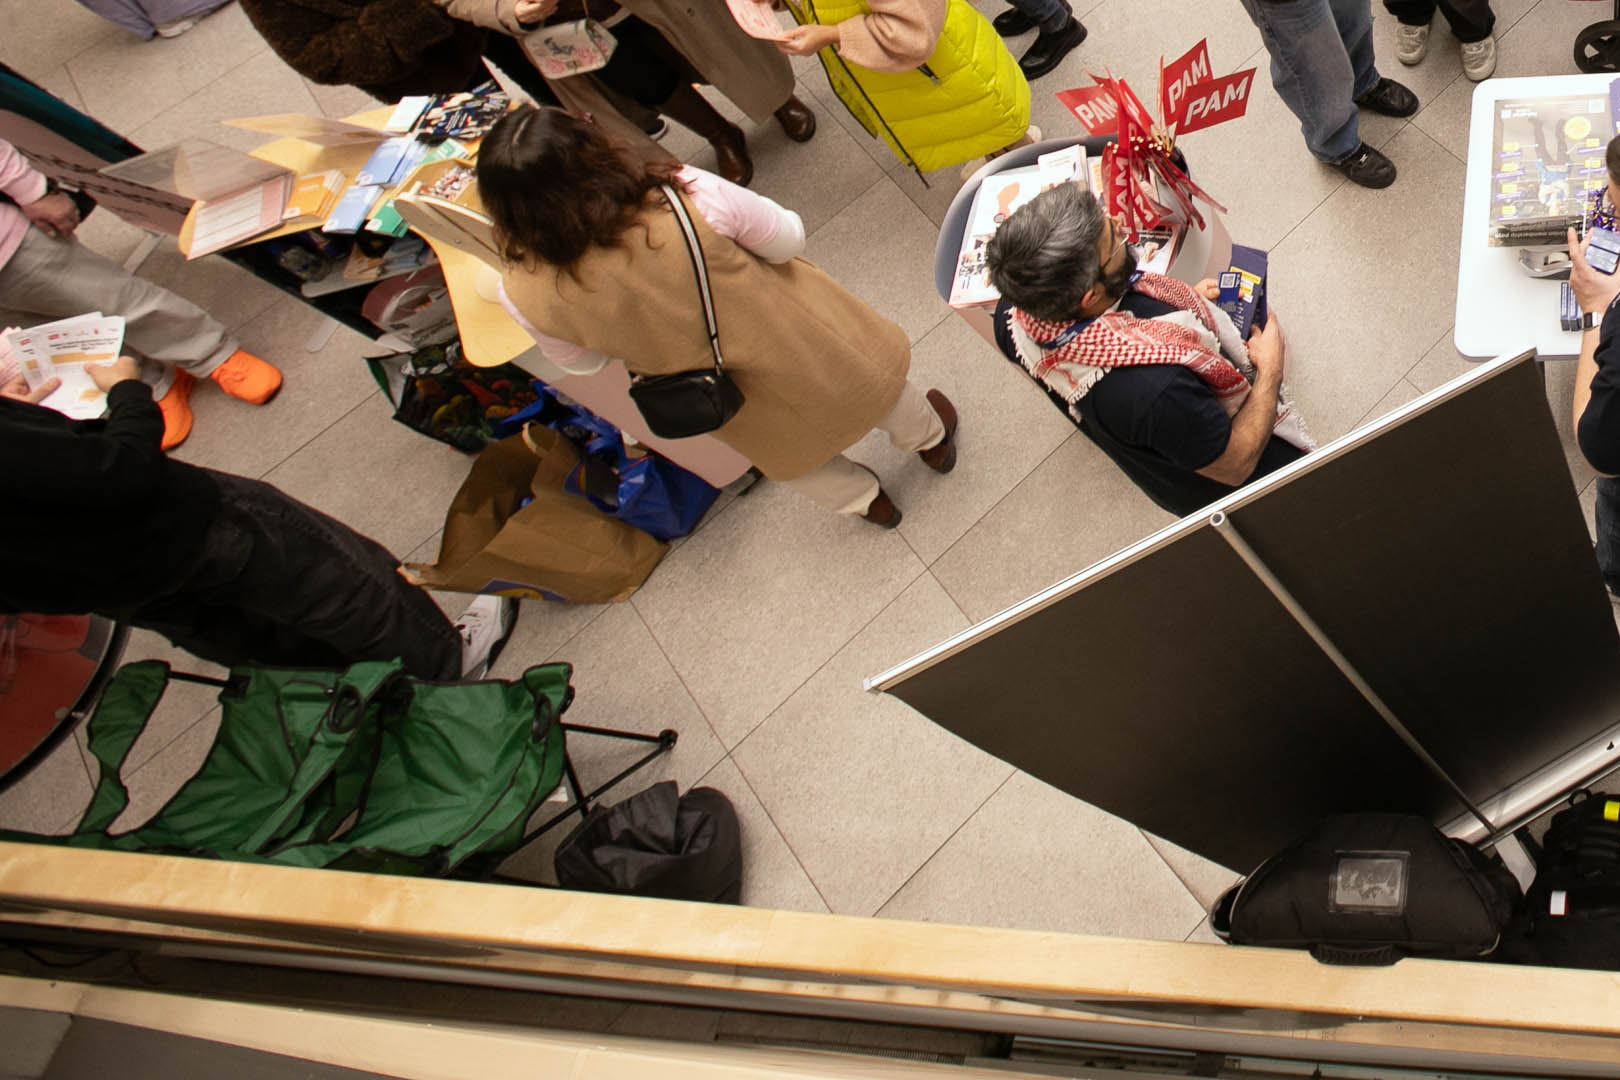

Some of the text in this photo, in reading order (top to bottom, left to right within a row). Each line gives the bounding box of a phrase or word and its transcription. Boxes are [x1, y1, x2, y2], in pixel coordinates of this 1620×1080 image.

[1168, 50, 1208, 114] PAM
[1184, 76, 1249, 127] PAM
[1074, 92, 1118, 129] PAM
